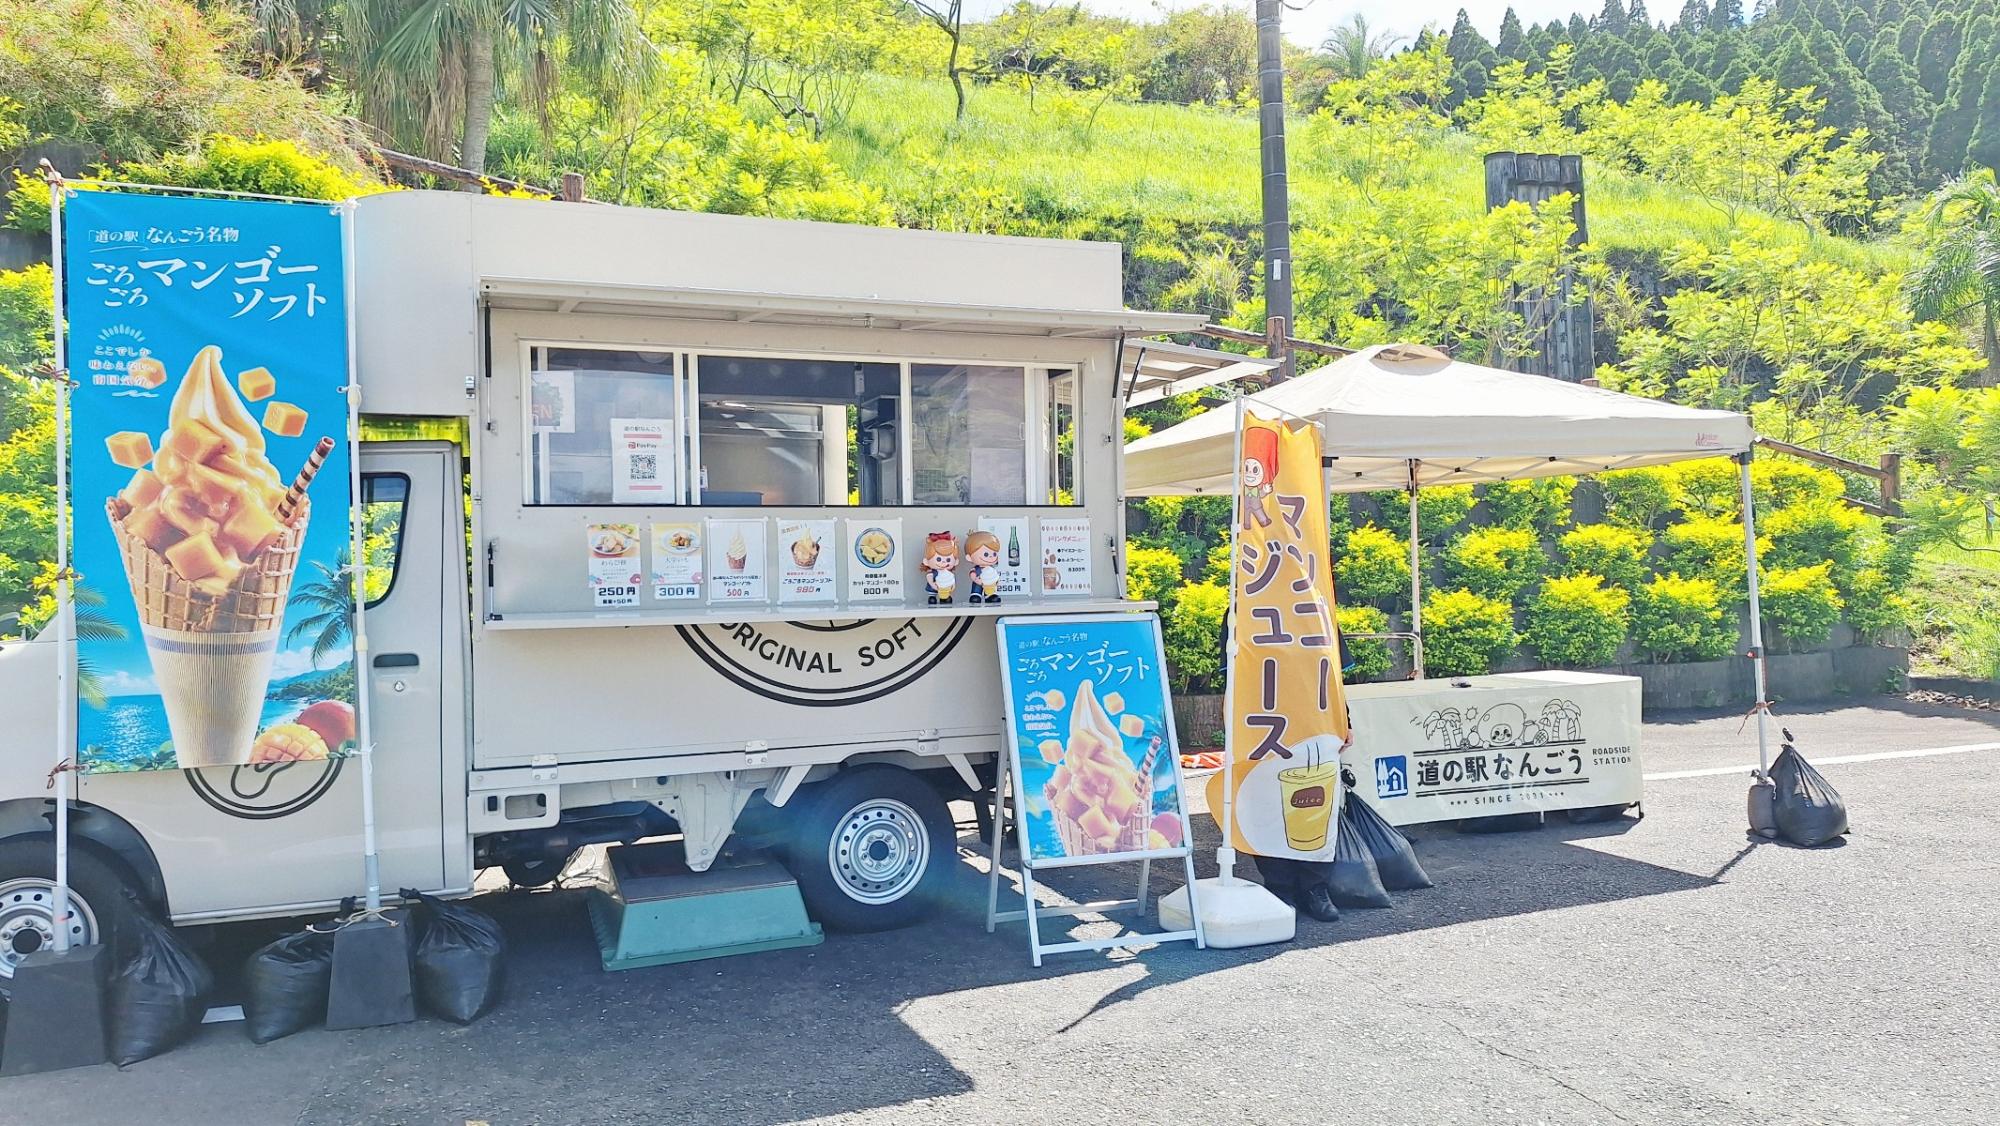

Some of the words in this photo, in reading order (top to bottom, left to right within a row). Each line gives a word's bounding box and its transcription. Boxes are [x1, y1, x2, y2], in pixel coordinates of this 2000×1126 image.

[137, 245, 319, 291] マンゴー
[227, 282, 327, 322] ソフト
[858, 617, 923, 667] SOFT
[1040, 640, 1129, 672] マンゴー
[1241, 541, 1293, 760] ジュース
[1095, 657, 1150, 686] ソフト
[1417, 748, 1583, 788] 道の駅なんごう
[1592, 745, 1632, 756] ROADSIDE
[1593, 756, 1632, 766] STATION
[1474, 794, 1512, 805] SINCE
